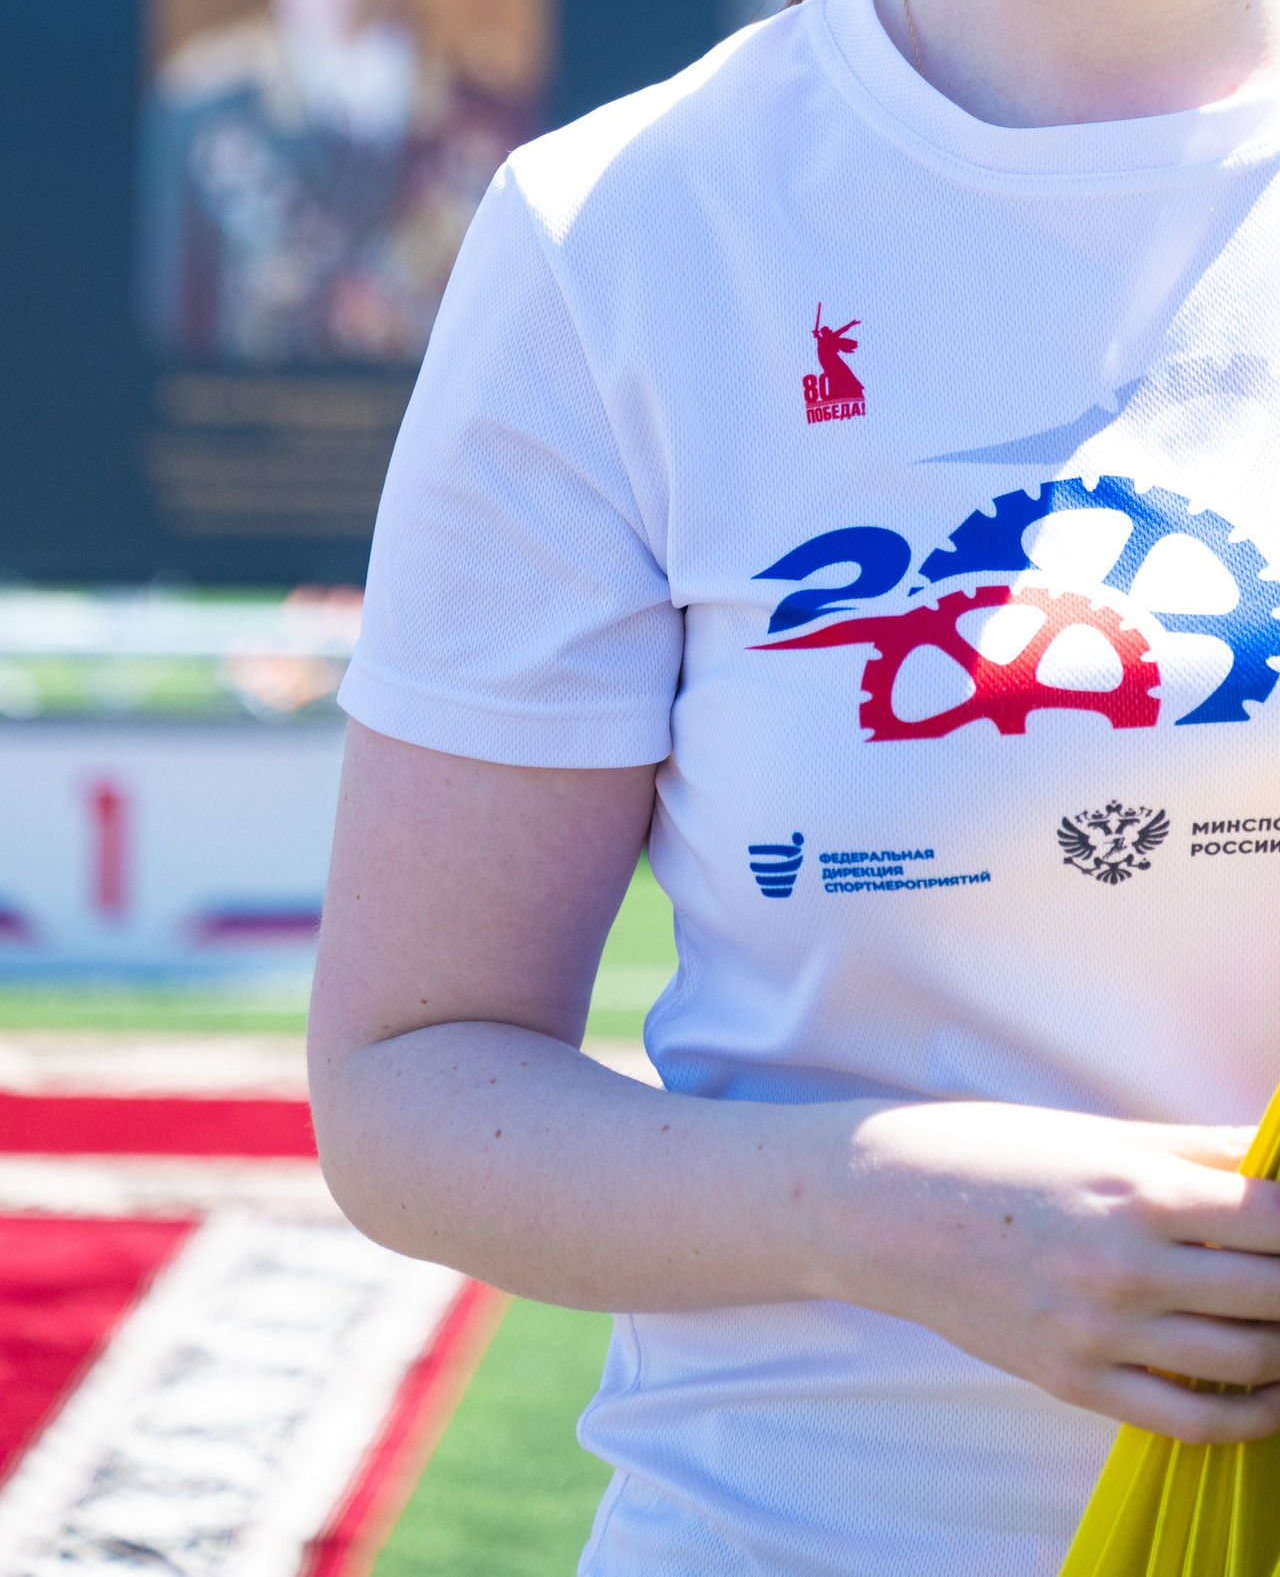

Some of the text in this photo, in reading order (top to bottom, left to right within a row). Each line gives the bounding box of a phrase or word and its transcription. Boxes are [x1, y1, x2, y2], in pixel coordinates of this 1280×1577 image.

[802, 373, 832, 403] 80
[805, 401, 867, 424] ПОБЕДА!
[818, 848, 935, 865] ФЕДЕРАЛЬНАЯ
[822, 865, 904, 880] ДИРЕКЦИЯ
[824, 870, 992, 894] СПОРТМЕРОПРИЯТИЙ
